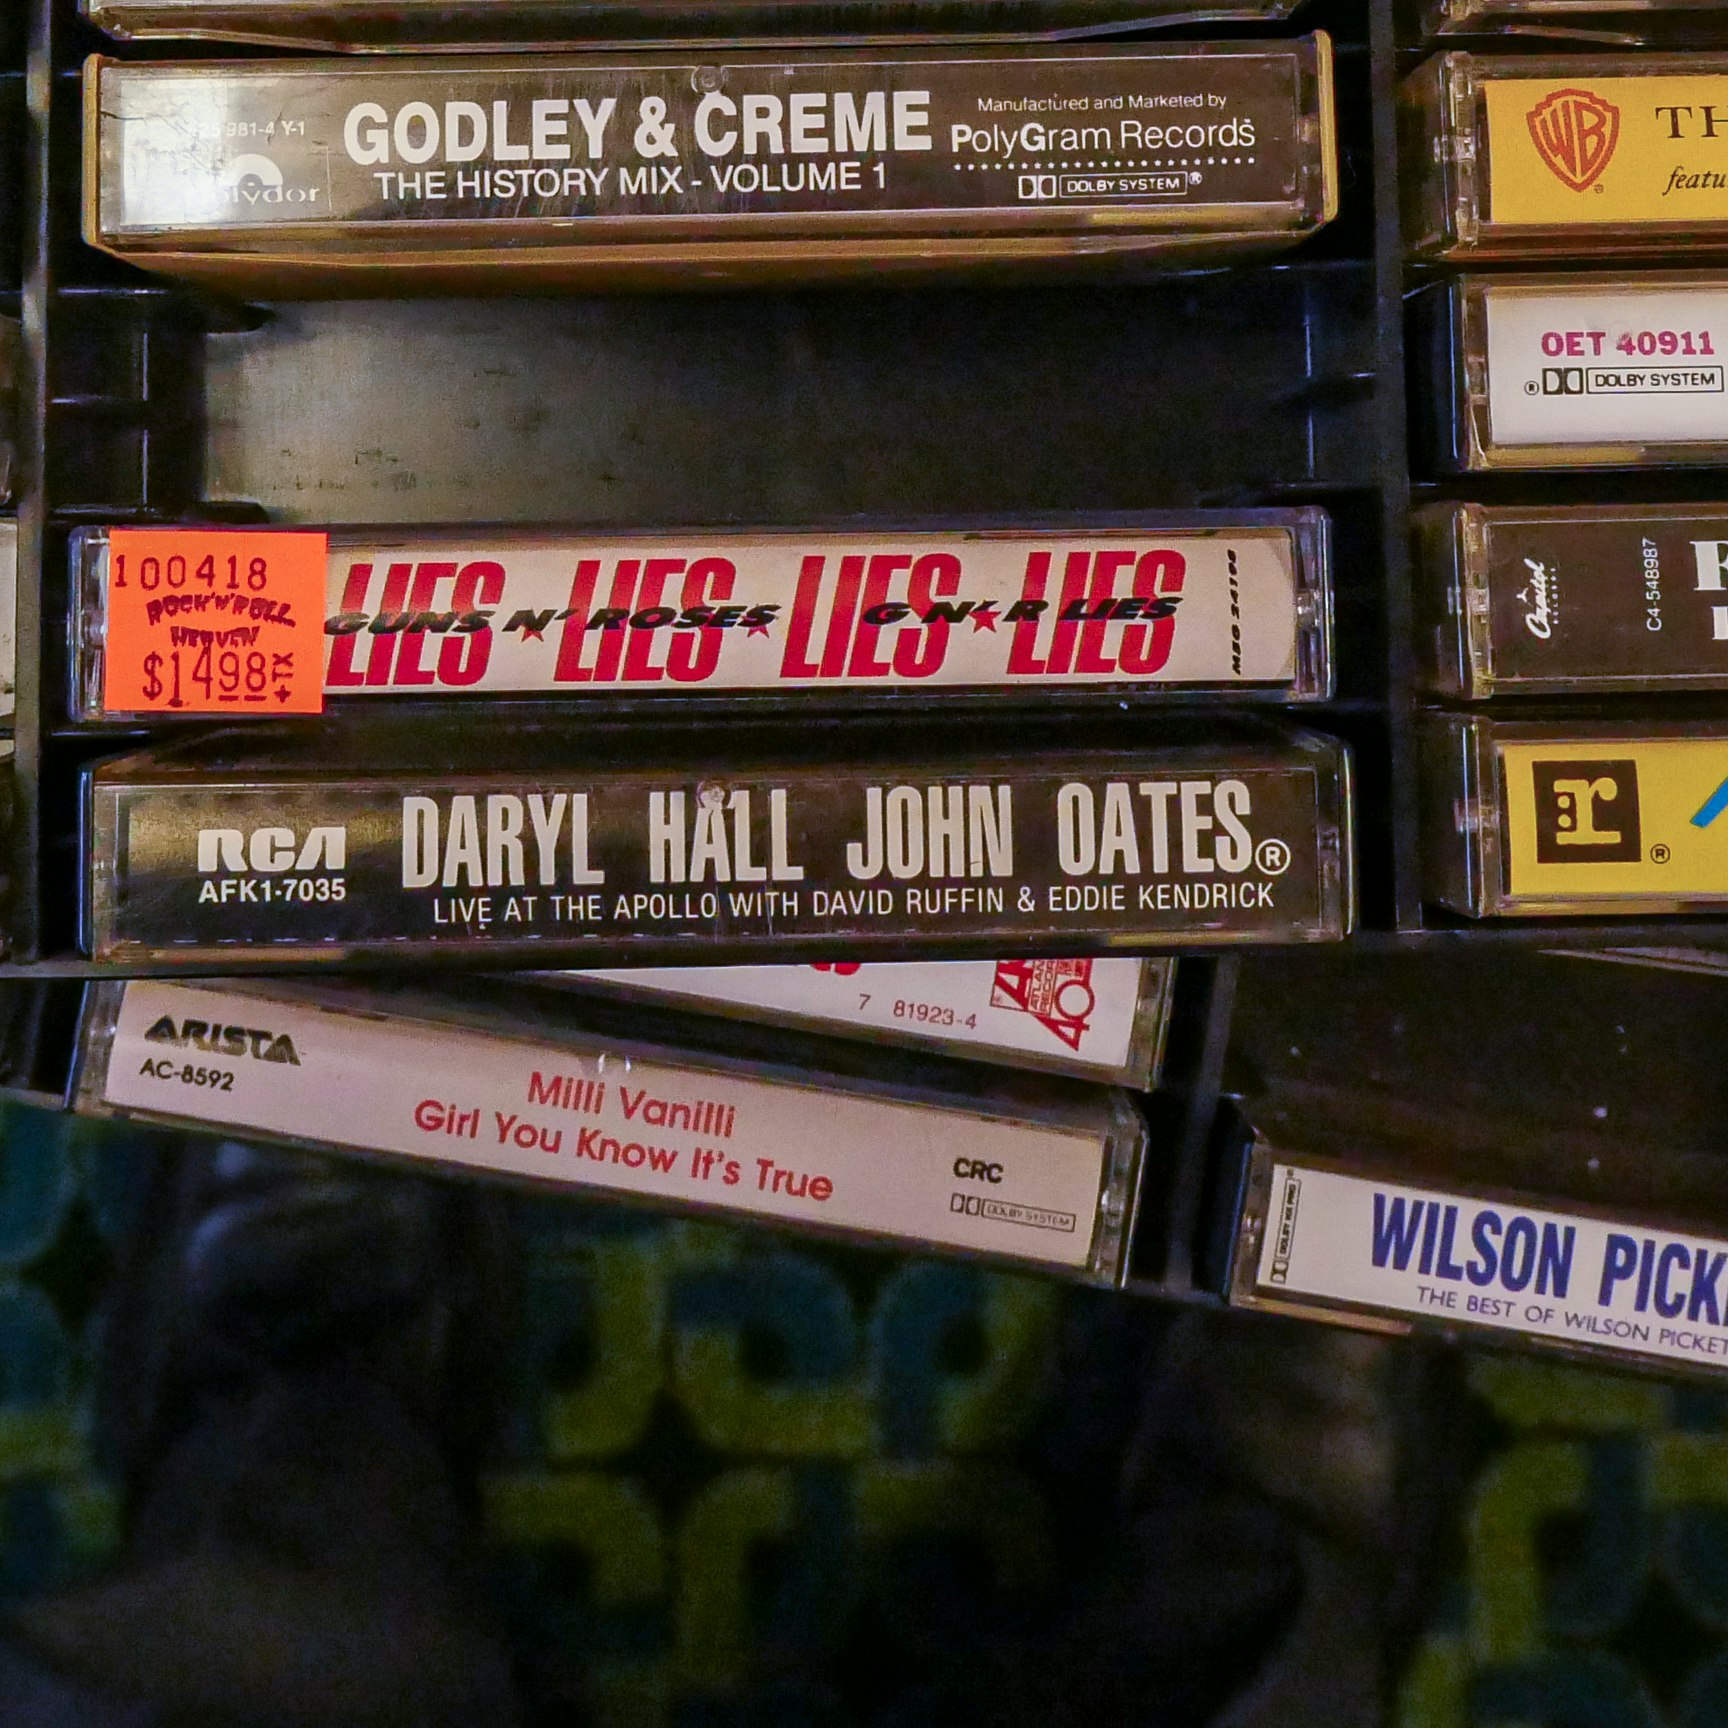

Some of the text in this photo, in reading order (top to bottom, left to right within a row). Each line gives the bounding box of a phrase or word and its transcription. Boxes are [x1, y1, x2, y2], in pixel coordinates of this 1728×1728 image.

[343, 90, 933, 165] GODLEY & CREME
[950, 118, 1257, 159] PolyGram Records
[114, 554, 268, 591] 100418
[402, 794, 605, 889] DARYL
[649, 789, 804, 886] HALL
[847, 785, 1013, 880] JOHN
[198, 879, 346, 904] AFK1-7035
[858, 994, 978, 1031] 7 81923-4
[139, 1058, 235, 1092] AC-8592
[527, 1071, 736, 1138] Milli Vanilli
[414, 1098, 834, 1202] Girl You Know It's True
[1372, 1192, 1576, 1299] WILSON
